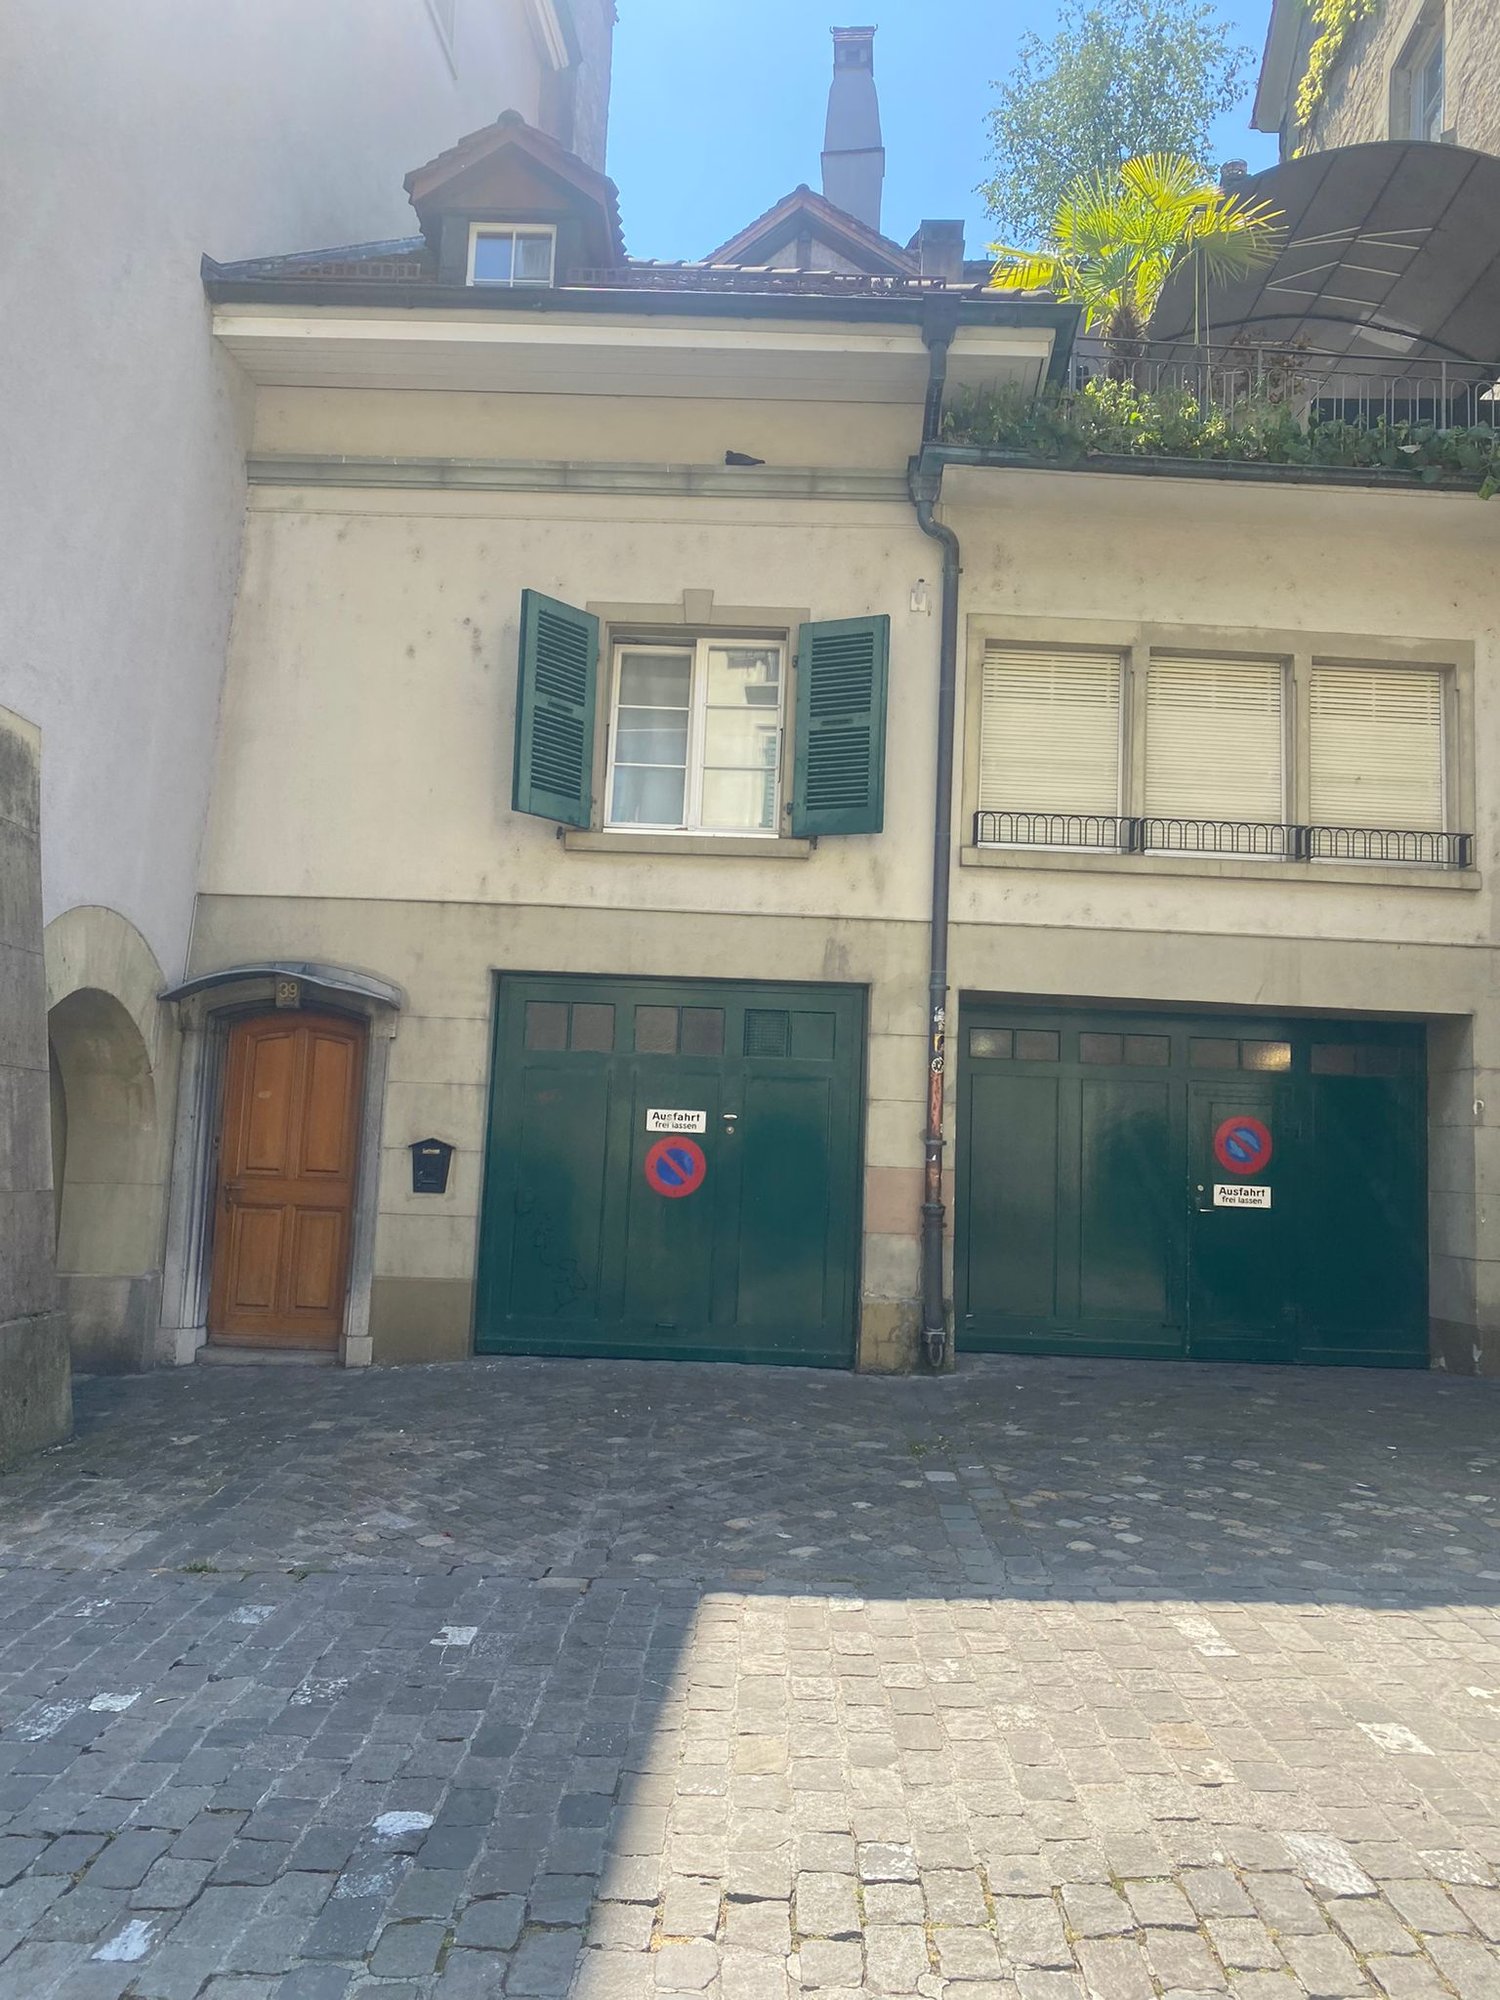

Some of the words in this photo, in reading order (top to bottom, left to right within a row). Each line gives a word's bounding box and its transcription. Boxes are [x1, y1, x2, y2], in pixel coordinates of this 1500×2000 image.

[279, 982, 298, 998] 39
[652, 1111, 700, 1121] Ausfahrt
[655, 1120, 669, 1128] frei
[1219, 1187, 1265, 1197] Ausfahrt
